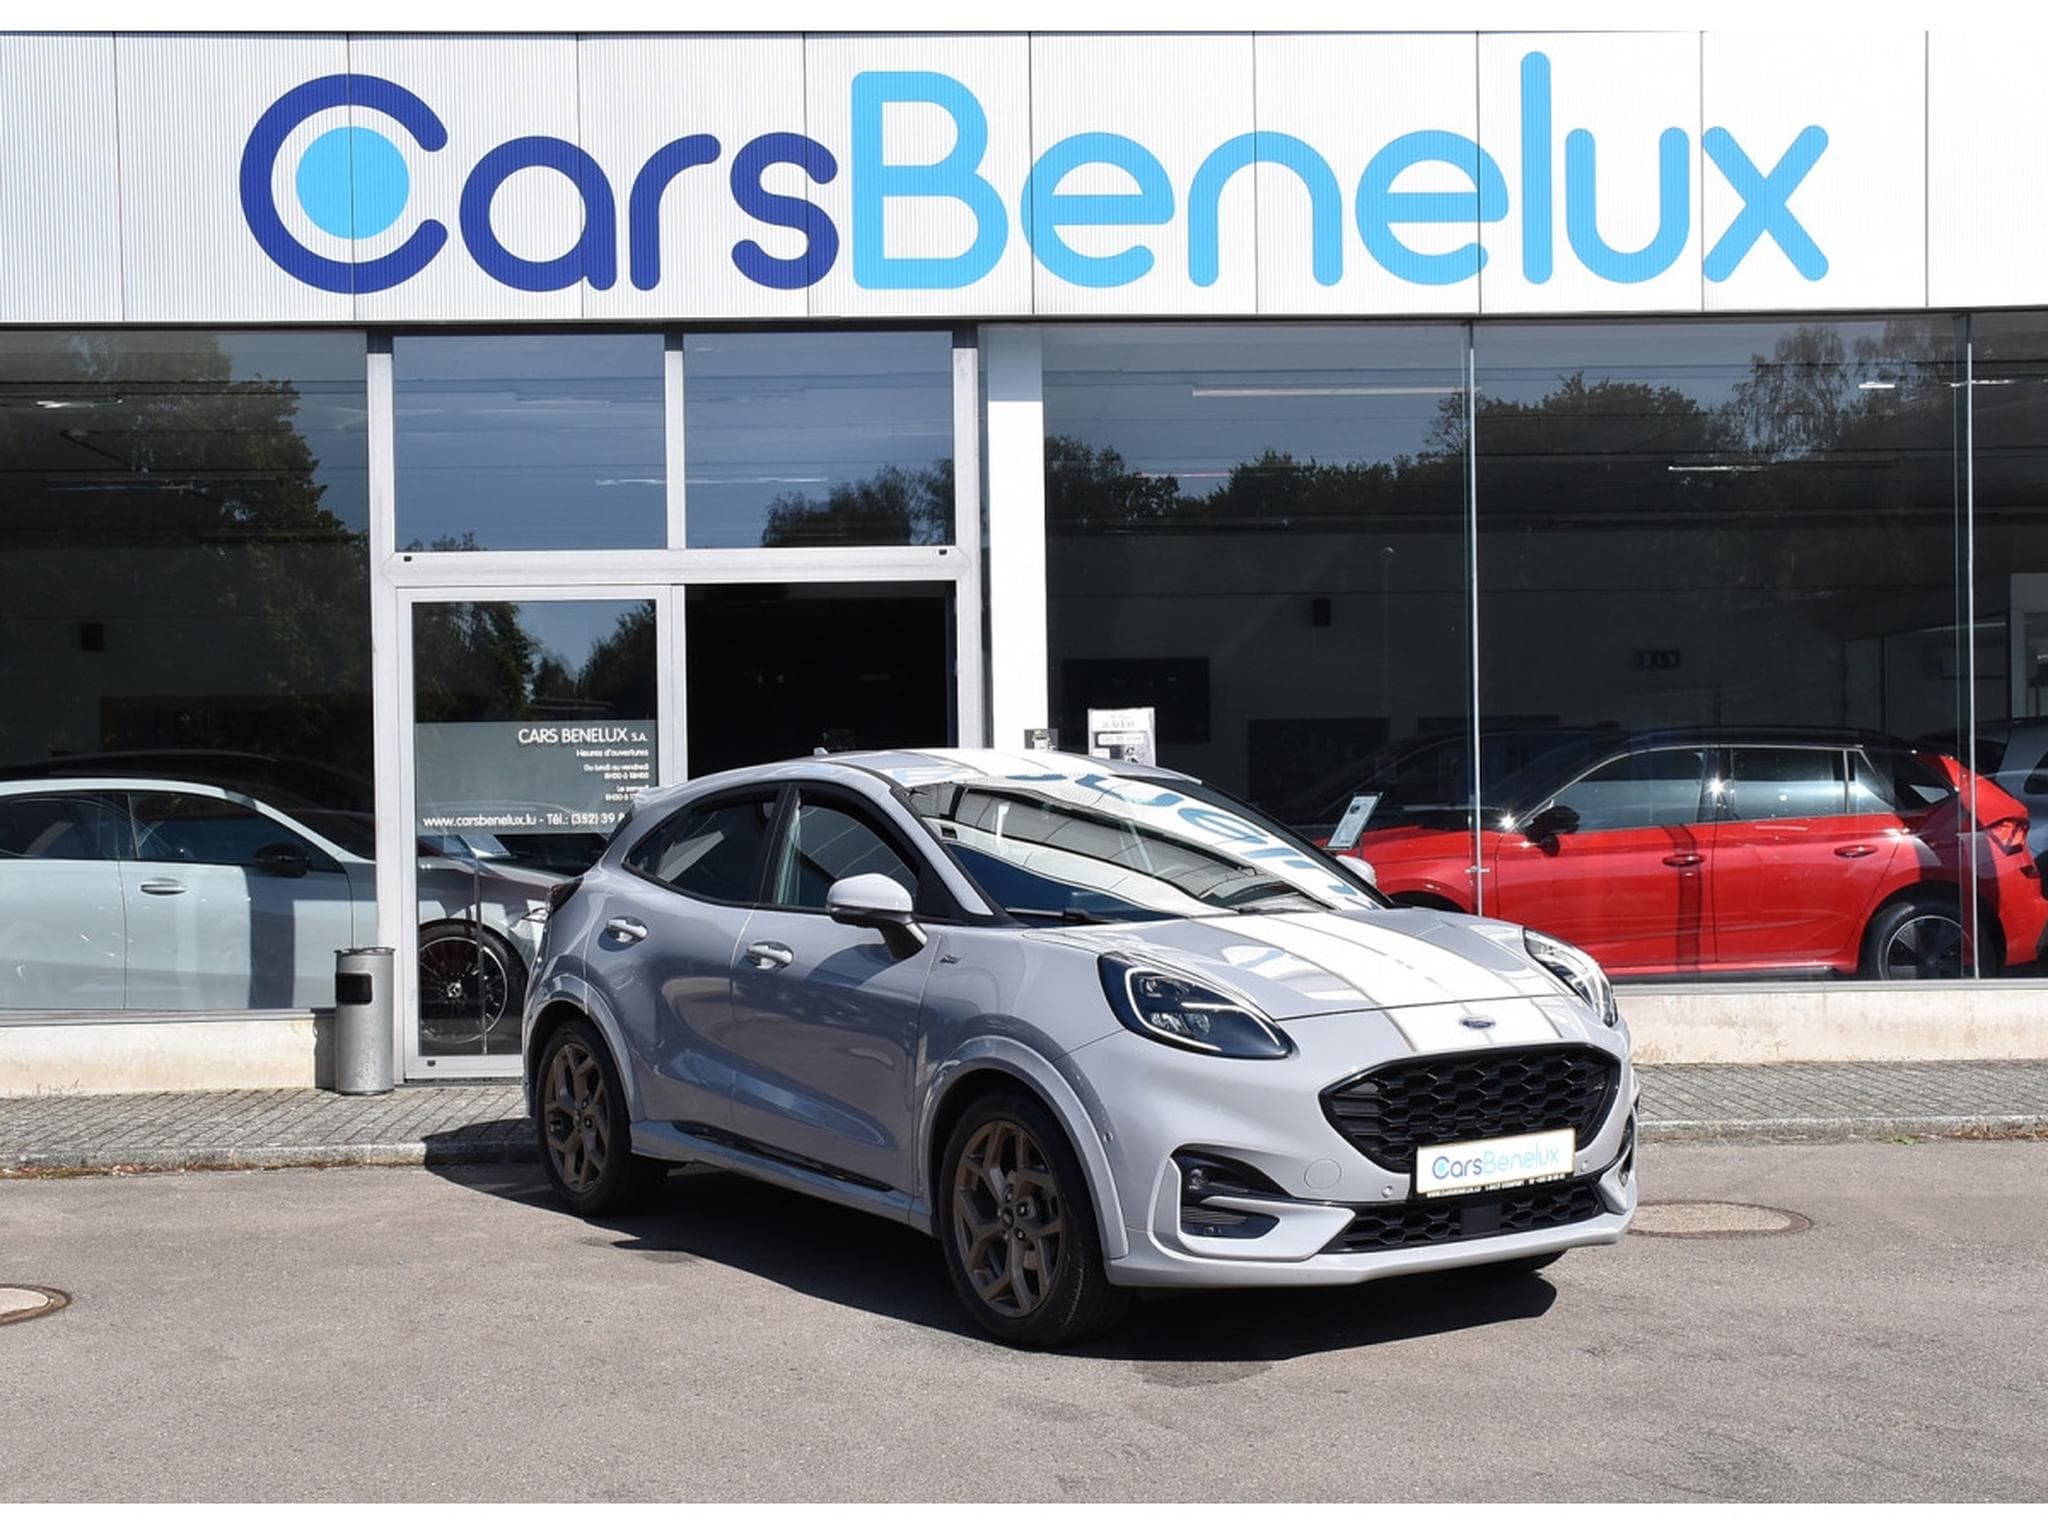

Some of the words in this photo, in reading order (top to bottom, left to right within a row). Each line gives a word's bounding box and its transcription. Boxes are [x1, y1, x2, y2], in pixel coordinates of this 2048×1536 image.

[239, 50, 1830, 295] CarsBenelux
[518, 728, 558, 743] CARS
[561, 728, 628, 743] BENELUX
[423, 813, 537, 827] www.carsbenelux.lu
[571, 812, 599, 827] (352)
[600, 812, 616, 825] 39
[1431, 1141, 1561, 1181] CarsBenelux
